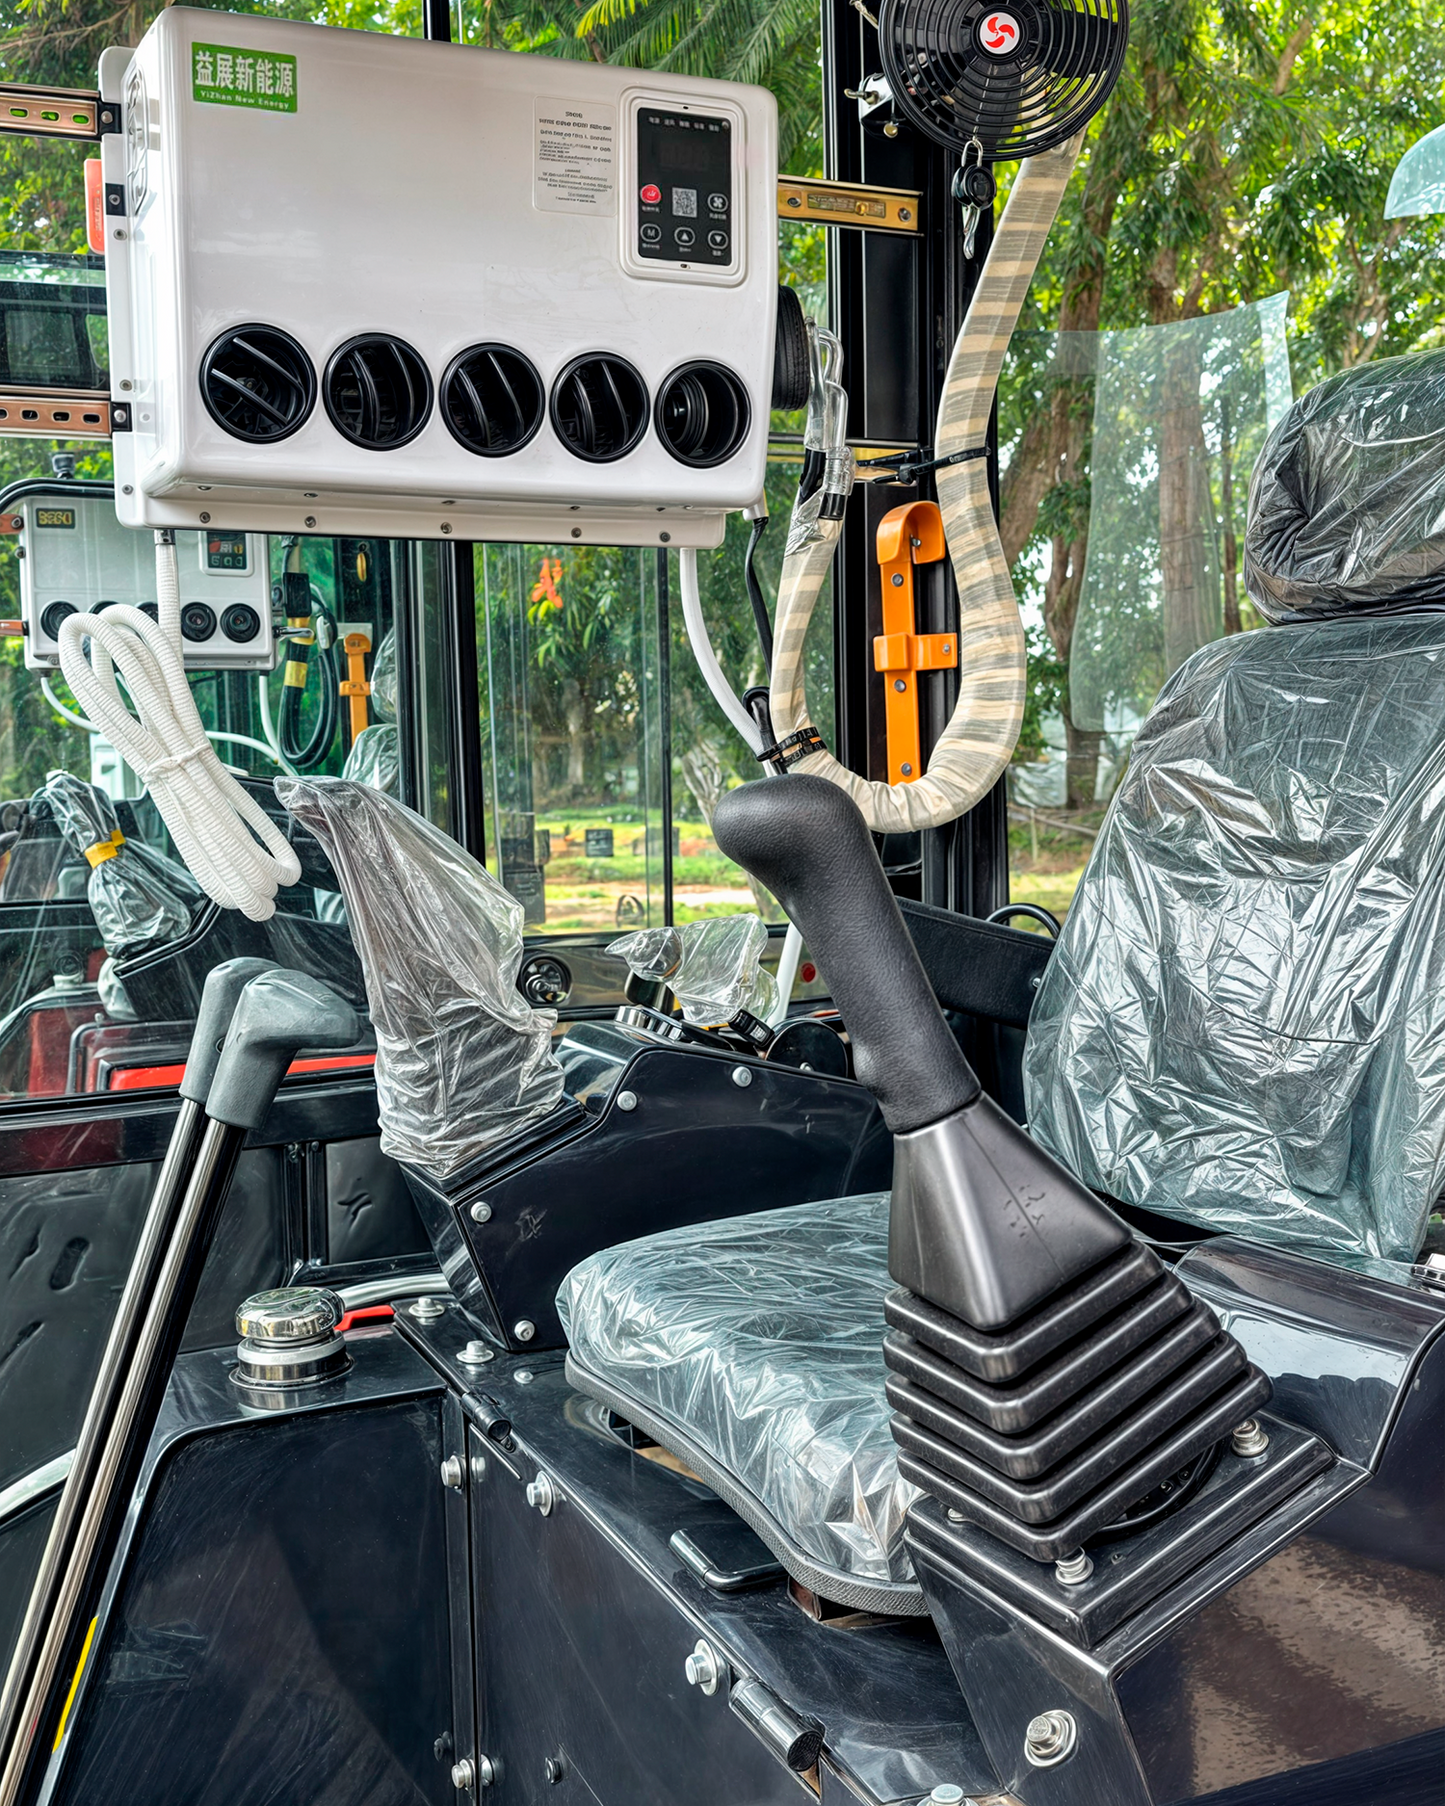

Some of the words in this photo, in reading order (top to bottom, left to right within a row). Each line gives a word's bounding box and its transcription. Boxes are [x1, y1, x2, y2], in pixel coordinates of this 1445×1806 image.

[195, 50, 293, 97] 益展新能源
[235, 95, 255, 104] New
[258, 98, 290, 110] Energy
[647, 228, 656, 238] M
